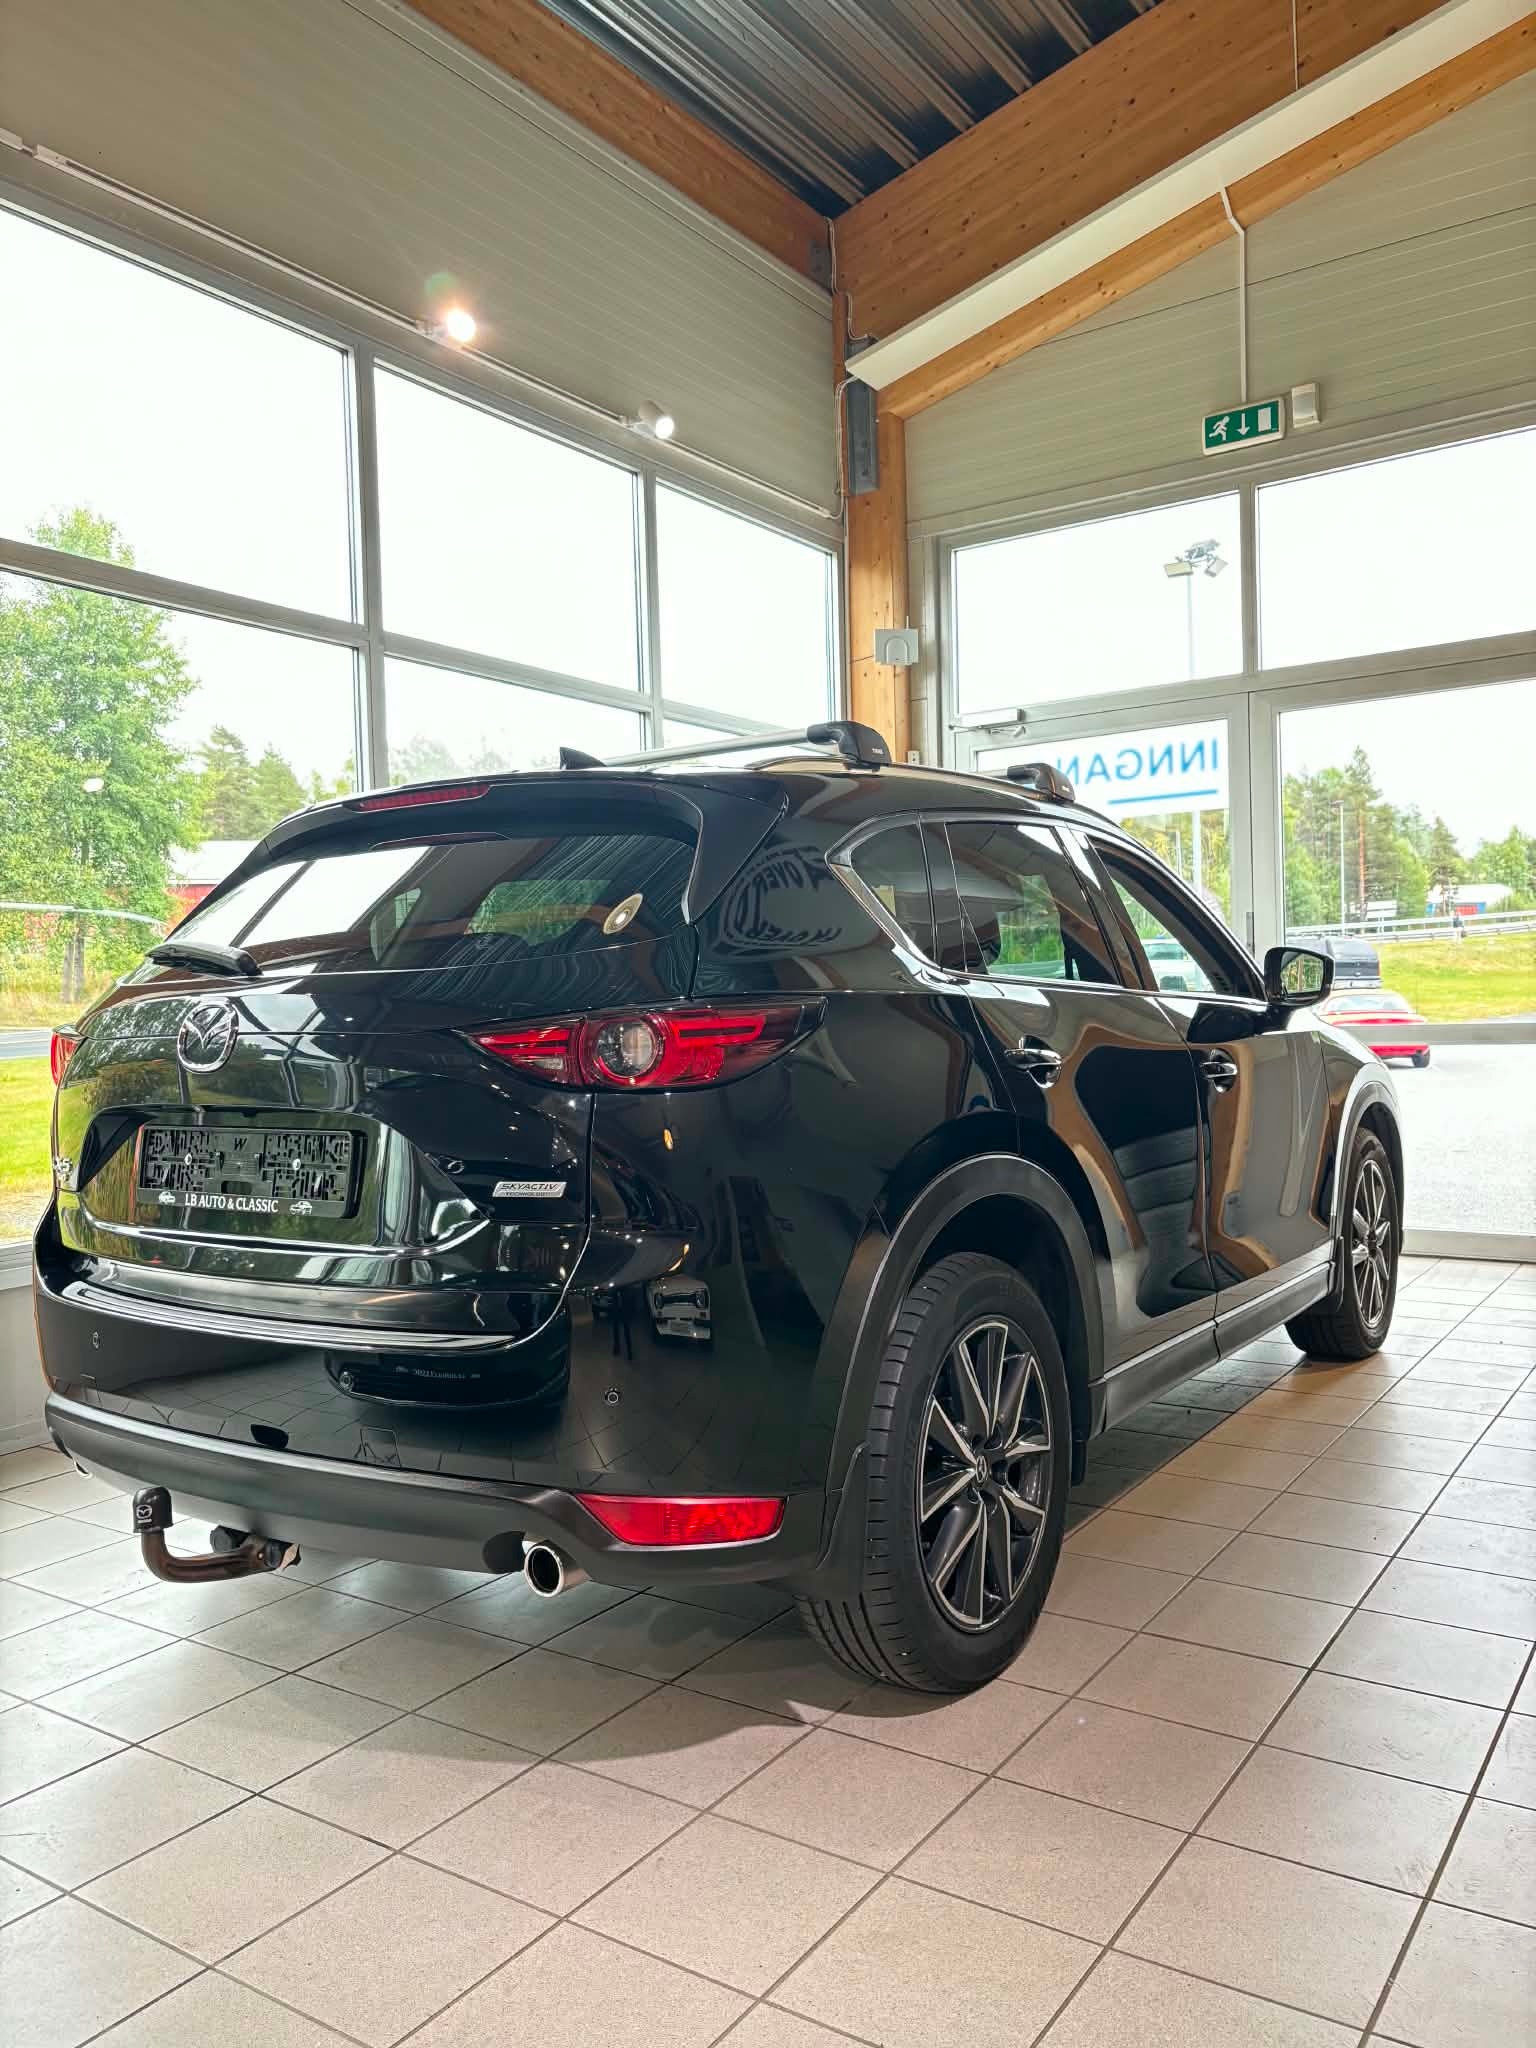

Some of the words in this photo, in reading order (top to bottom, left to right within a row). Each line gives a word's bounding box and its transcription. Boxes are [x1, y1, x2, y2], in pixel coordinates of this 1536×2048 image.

[184, 1193, 198, 1207] LB
[198, 1194, 226, 1209] AUTO
[227, 1198, 234, 1210] &
[235, 1197, 279, 1213] CLASSIC
